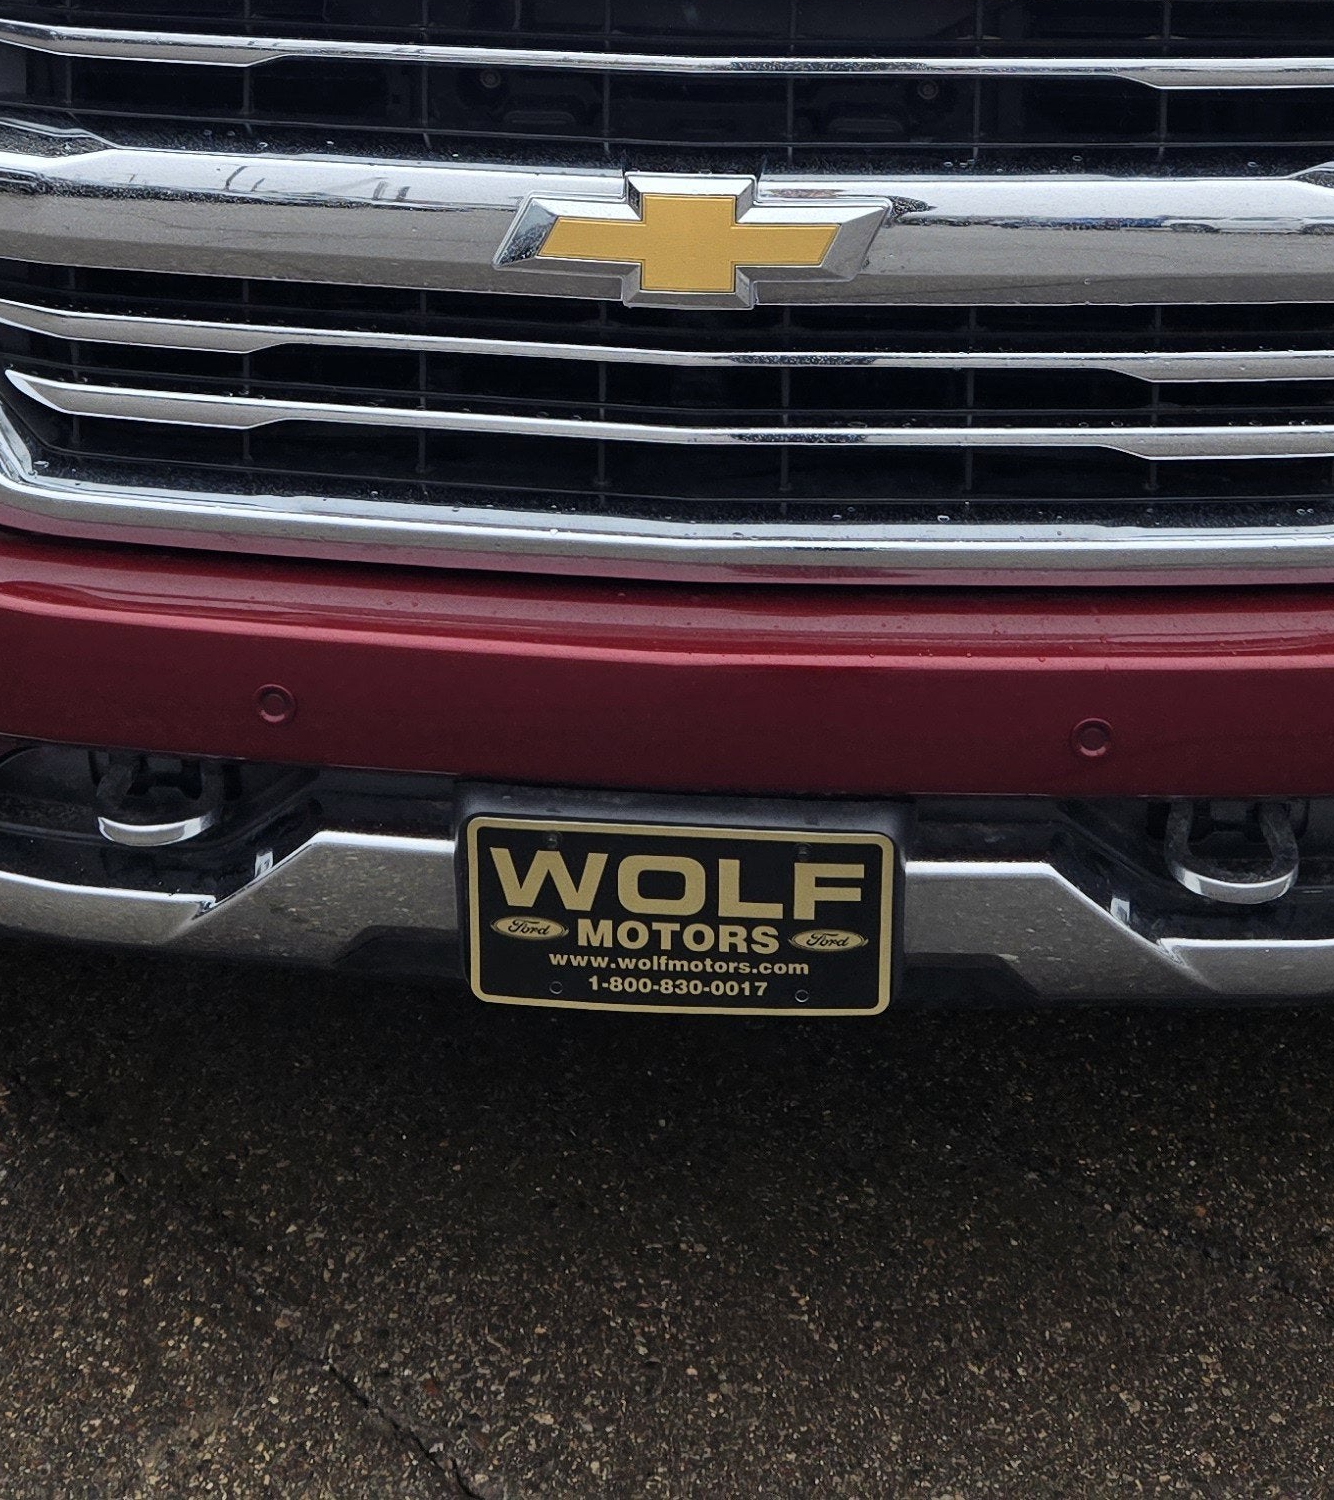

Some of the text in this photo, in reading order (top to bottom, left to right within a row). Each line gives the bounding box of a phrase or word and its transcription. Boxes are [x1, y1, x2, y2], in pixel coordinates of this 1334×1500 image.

[490, 847, 865, 921] WOLF
[507, 919, 551, 937] Ford
[577, 919, 780, 954] MOTORS
[806, 933, 851, 949] Ford
[549, 954, 810, 975] www.wolfmotors.com
[588, 976, 768, 997] 1-800-830-0017
